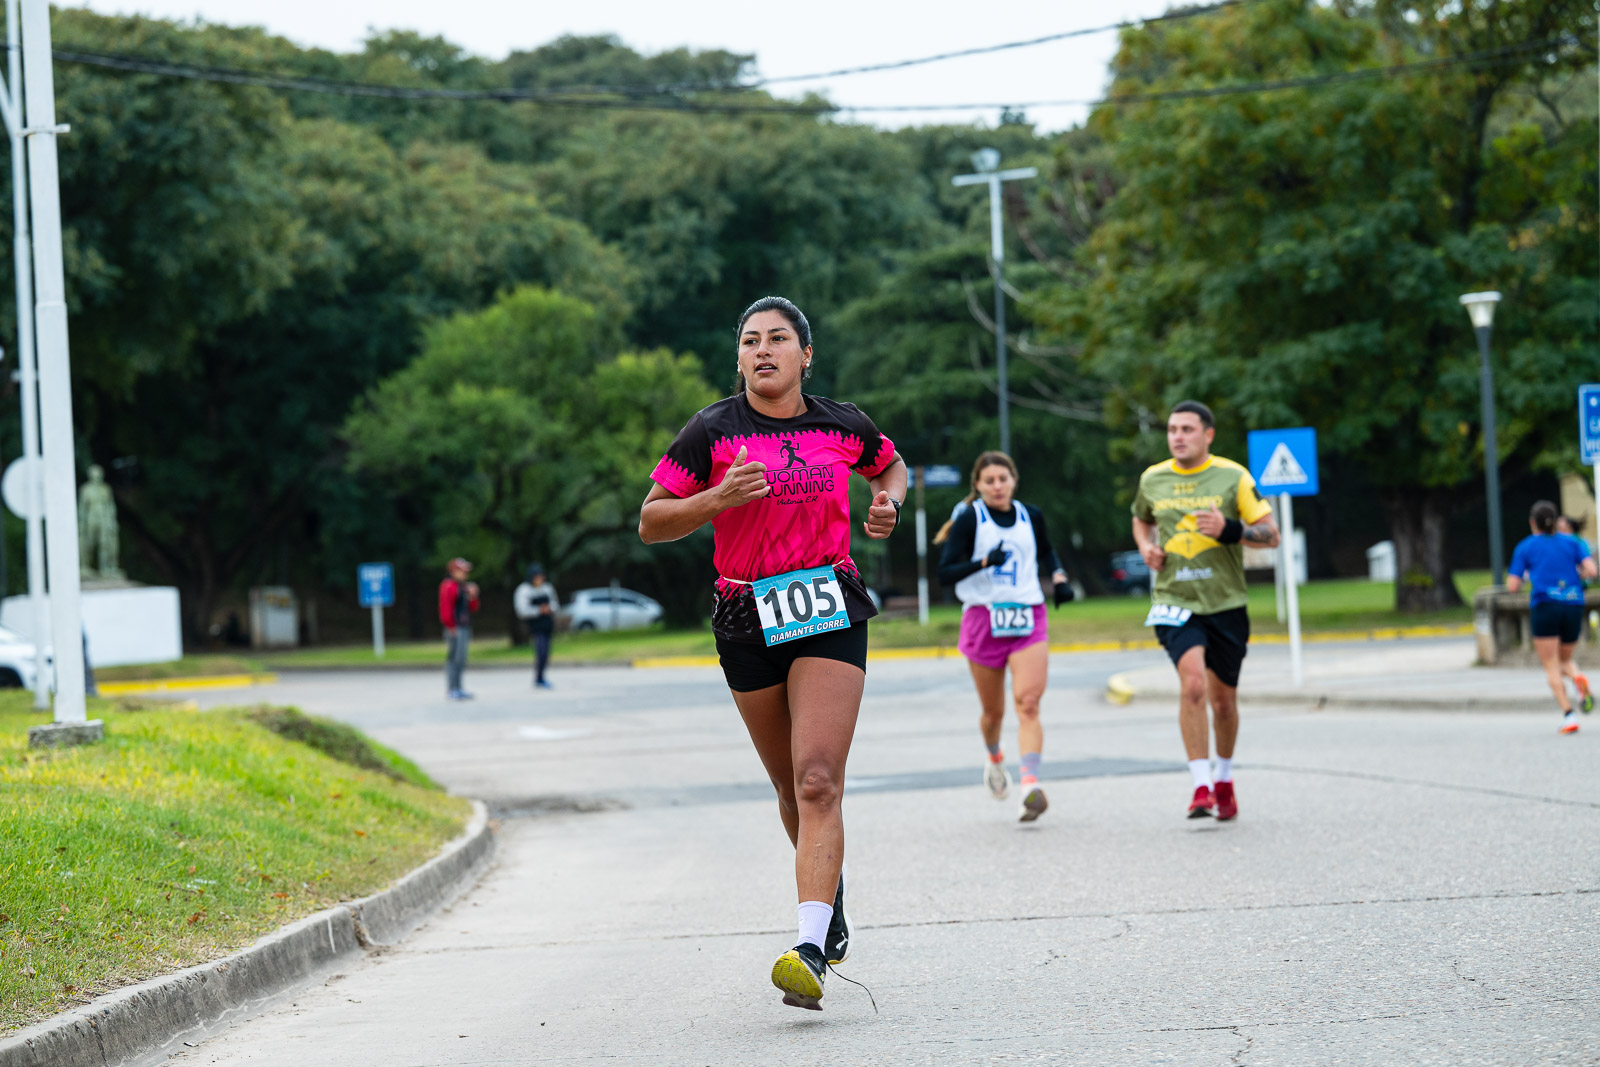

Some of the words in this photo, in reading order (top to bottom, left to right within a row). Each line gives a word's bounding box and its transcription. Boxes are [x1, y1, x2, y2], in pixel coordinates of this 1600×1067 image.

[762, 576, 837, 628] 105
[770, 625, 815, 643] DIAMANTE
[816, 618, 845, 631] CORRE
